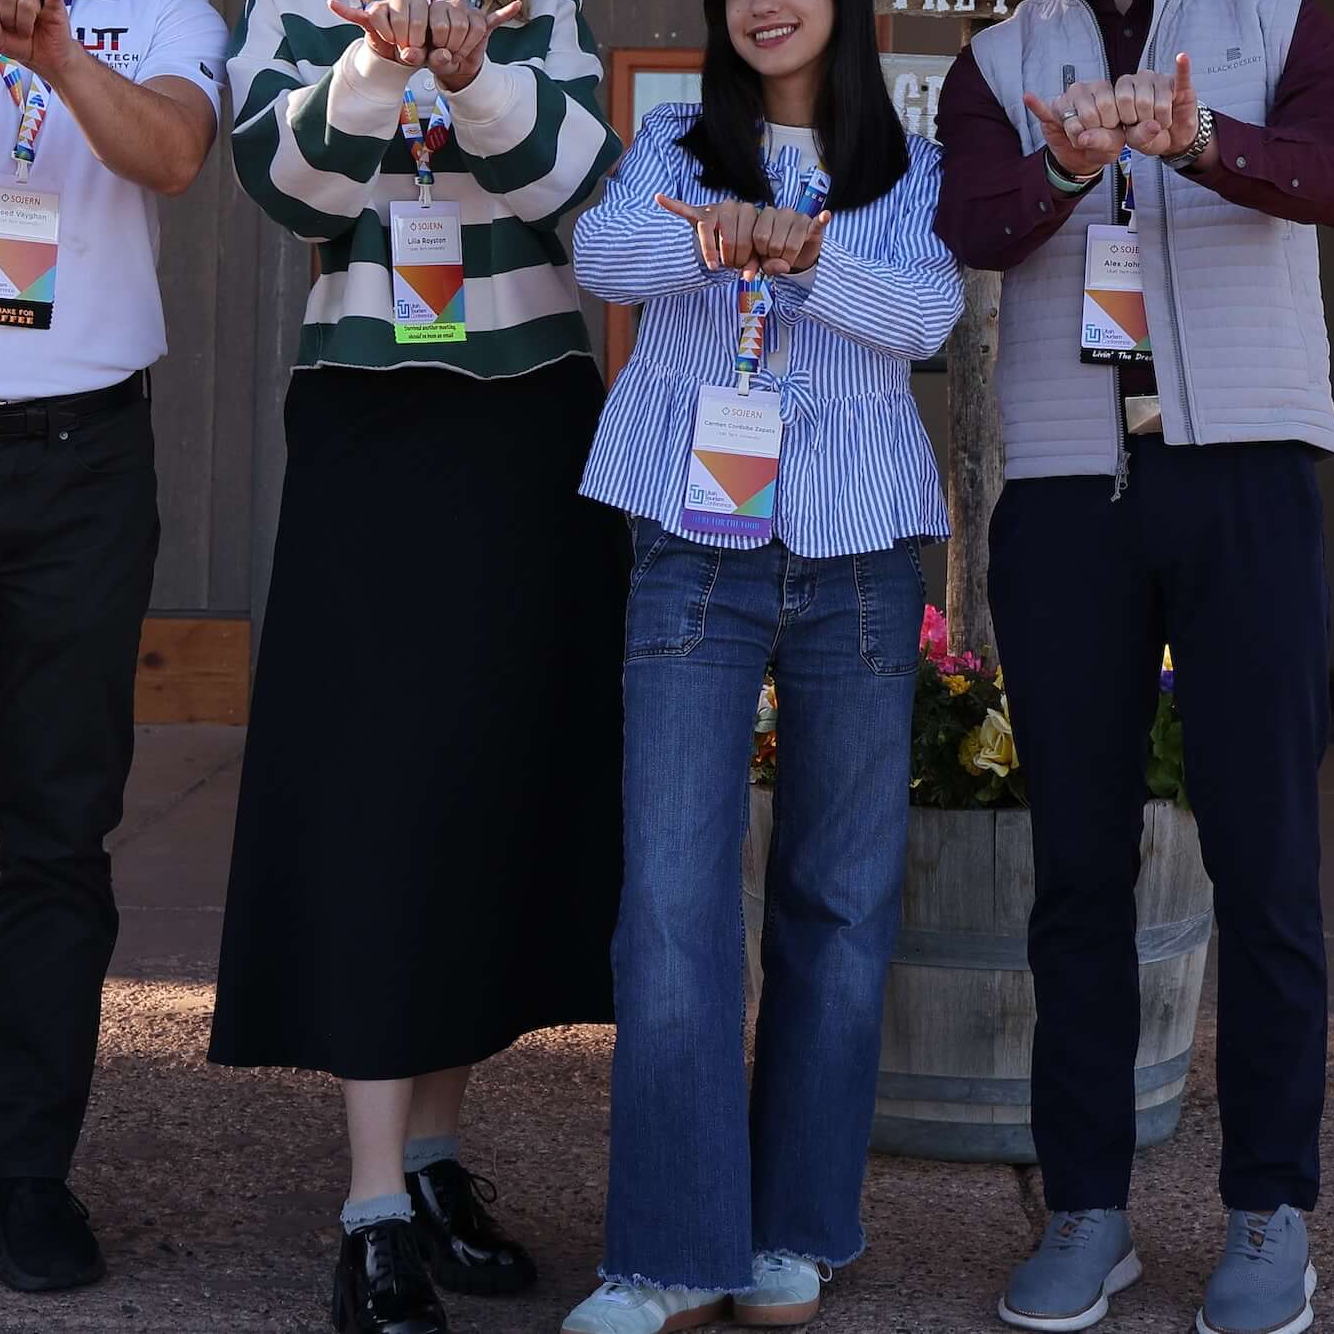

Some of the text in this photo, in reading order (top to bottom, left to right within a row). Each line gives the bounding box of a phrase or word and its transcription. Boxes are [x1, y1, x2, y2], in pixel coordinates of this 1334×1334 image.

[105, 53, 139, 62] TECH
[1207, 65, 1233, 74] BLACK
[11, 194, 41, 206] SOJERN
[418, 221, 443, 231] SOJERN
[18, 309, 34, 317] FOR
[1118, 351, 1132, 360] The
[731, 408, 763, 419] SOJERN
